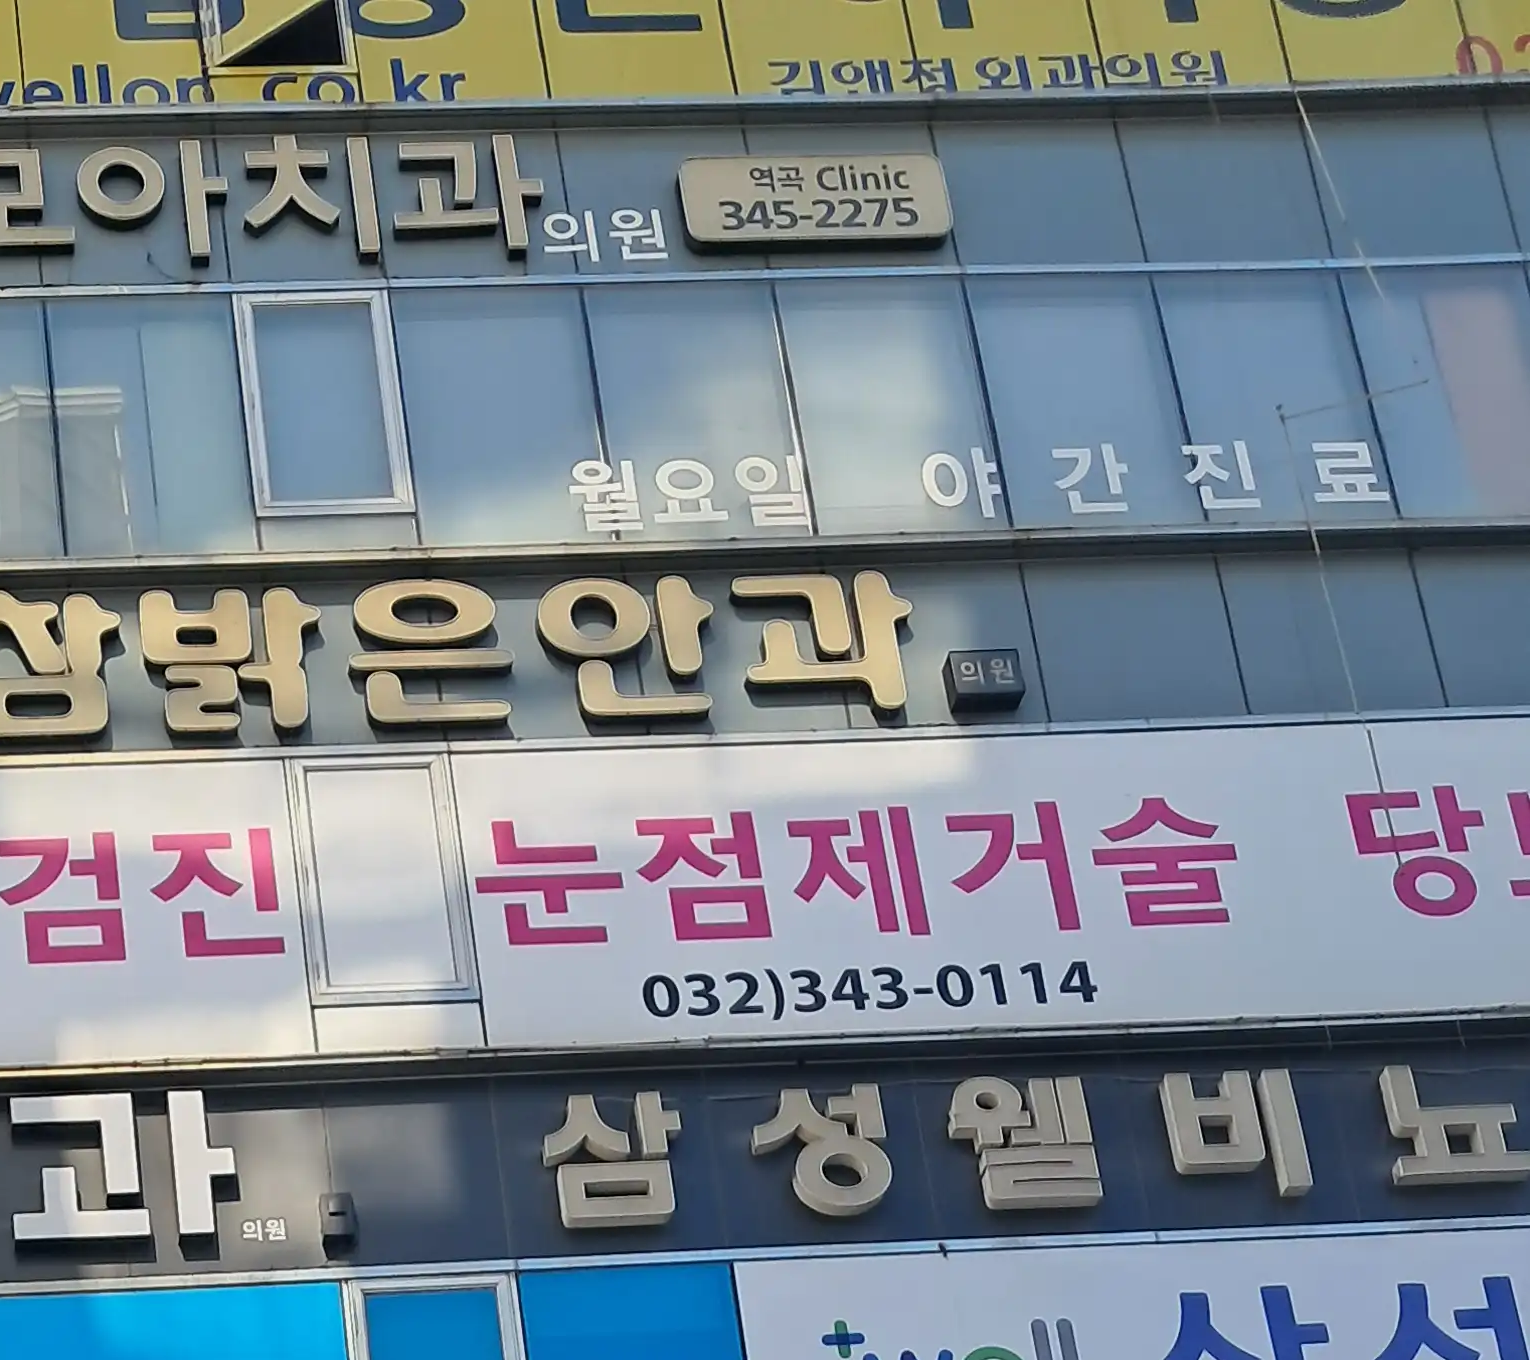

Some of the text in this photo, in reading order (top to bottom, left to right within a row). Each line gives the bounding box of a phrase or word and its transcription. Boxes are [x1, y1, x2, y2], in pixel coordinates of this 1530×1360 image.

[748, 162, 910, 194] 역곡 Clinic
[543, 206, 668, 263] 의원
[718, 196, 920, 233] 345-2275
[569, 450, 809, 536] 월요일
[957, 655, 1017, 688] 의원
[474, 796, 1239, 947] 눈점제거술
[640, 960, 1099, 1022] 032)343-0114
[241, 1216, 288, 1243] 의원
